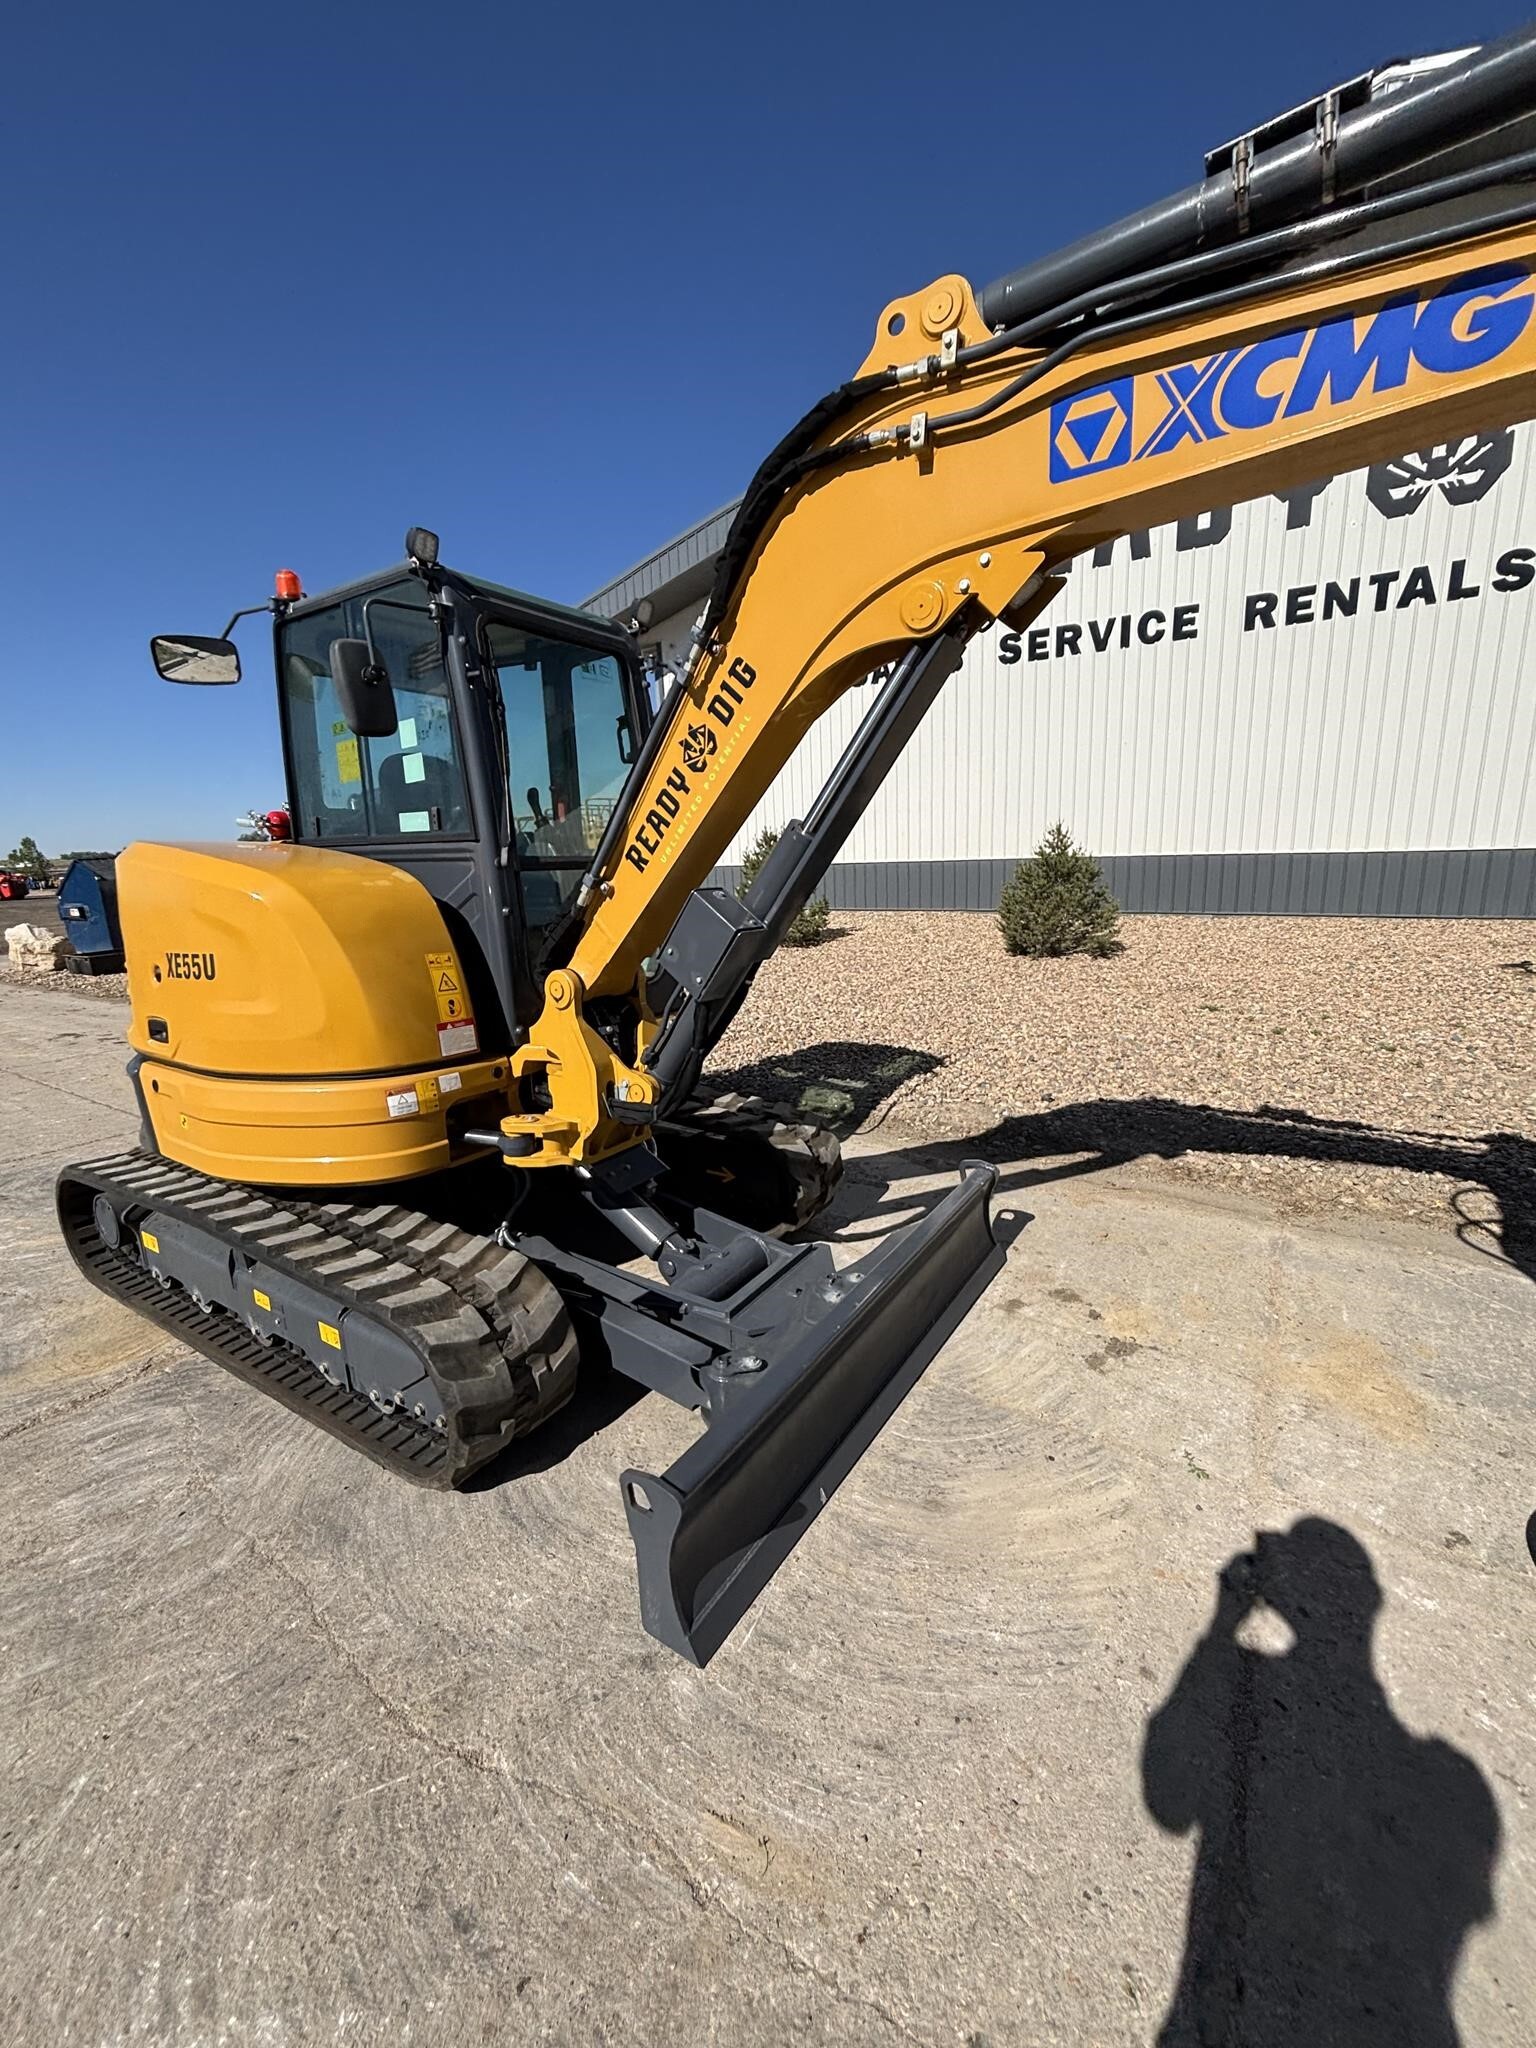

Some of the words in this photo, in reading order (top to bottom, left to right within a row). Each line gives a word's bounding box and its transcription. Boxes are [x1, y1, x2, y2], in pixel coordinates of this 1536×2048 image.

[1132, 262, 1536, 462] XCMG
[997, 604, 1200, 665] SERVICE
[1243, 548, 1536, 632] RENTALS
[625, 766, 692, 874] READY
[707, 656, 757, 727] DIG
[660, 795, 703, 864] UNLIMITED
[703, 714, 752, 790] POTENTIAL
[165, 952, 216, 981] XE55U
